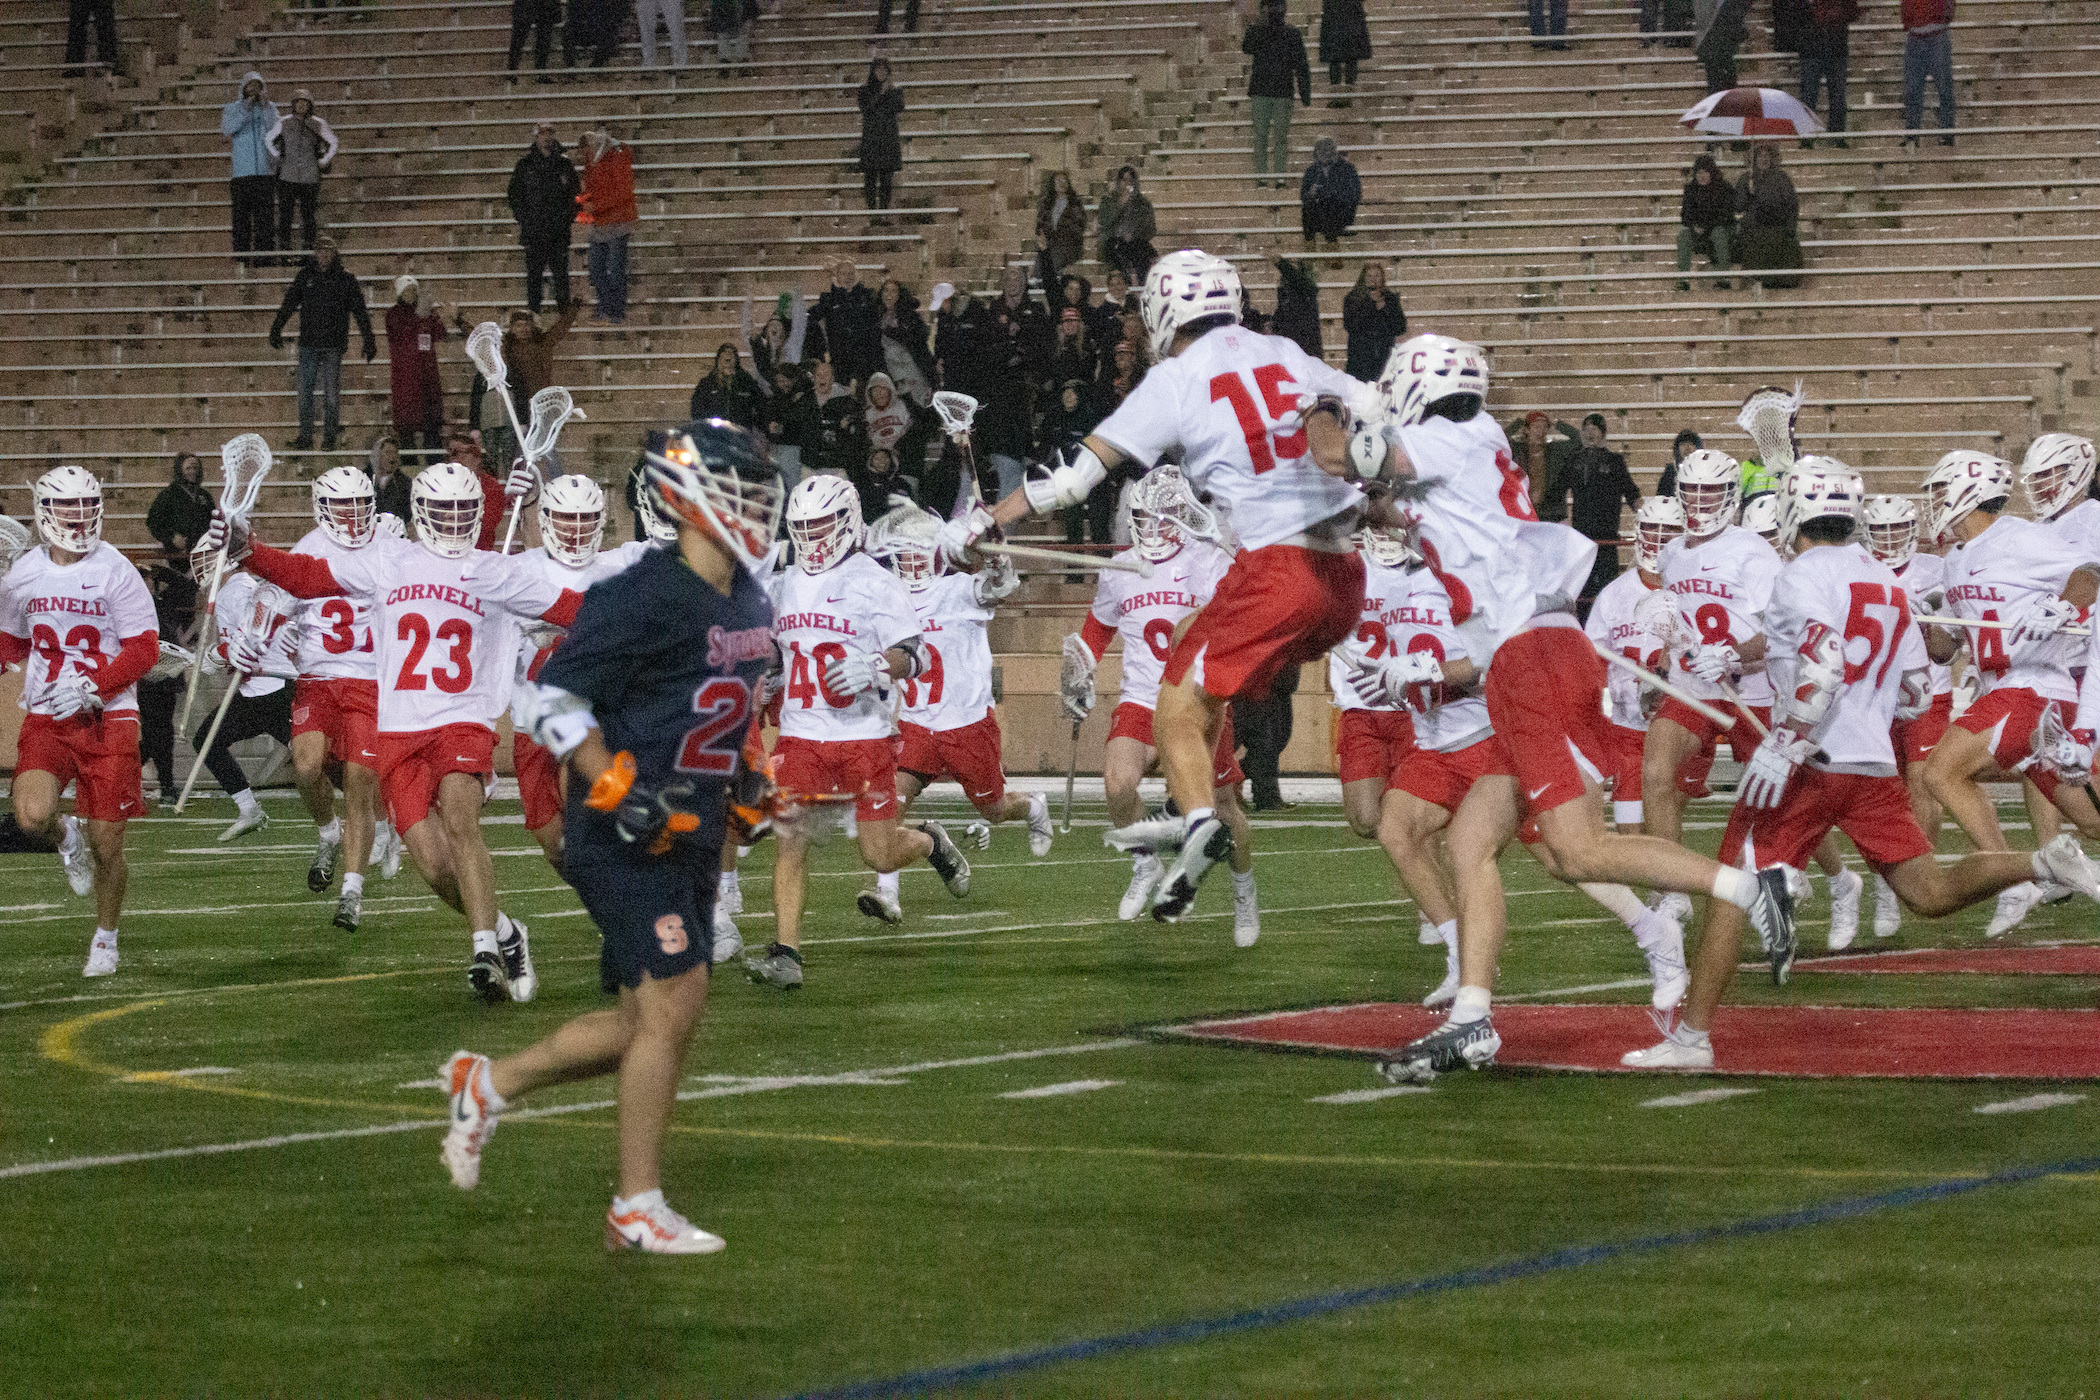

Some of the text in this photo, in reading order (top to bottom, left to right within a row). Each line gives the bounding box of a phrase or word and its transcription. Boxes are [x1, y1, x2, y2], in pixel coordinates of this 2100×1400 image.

[1160, 274, 1173, 297] C
[1213, 279, 1225, 291] 15
[1411, 351, 1427, 374] C
[1209, 363, 1309, 476] 15
[1968, 462, 1983, 478] C
[1788, 475, 1800, 496] C
[1834, 483, 1845, 493] 51
[386, 584, 485, 618] CORNELL
[394, 613, 473, 694] 23
[675, 676, 751, 776] 2
